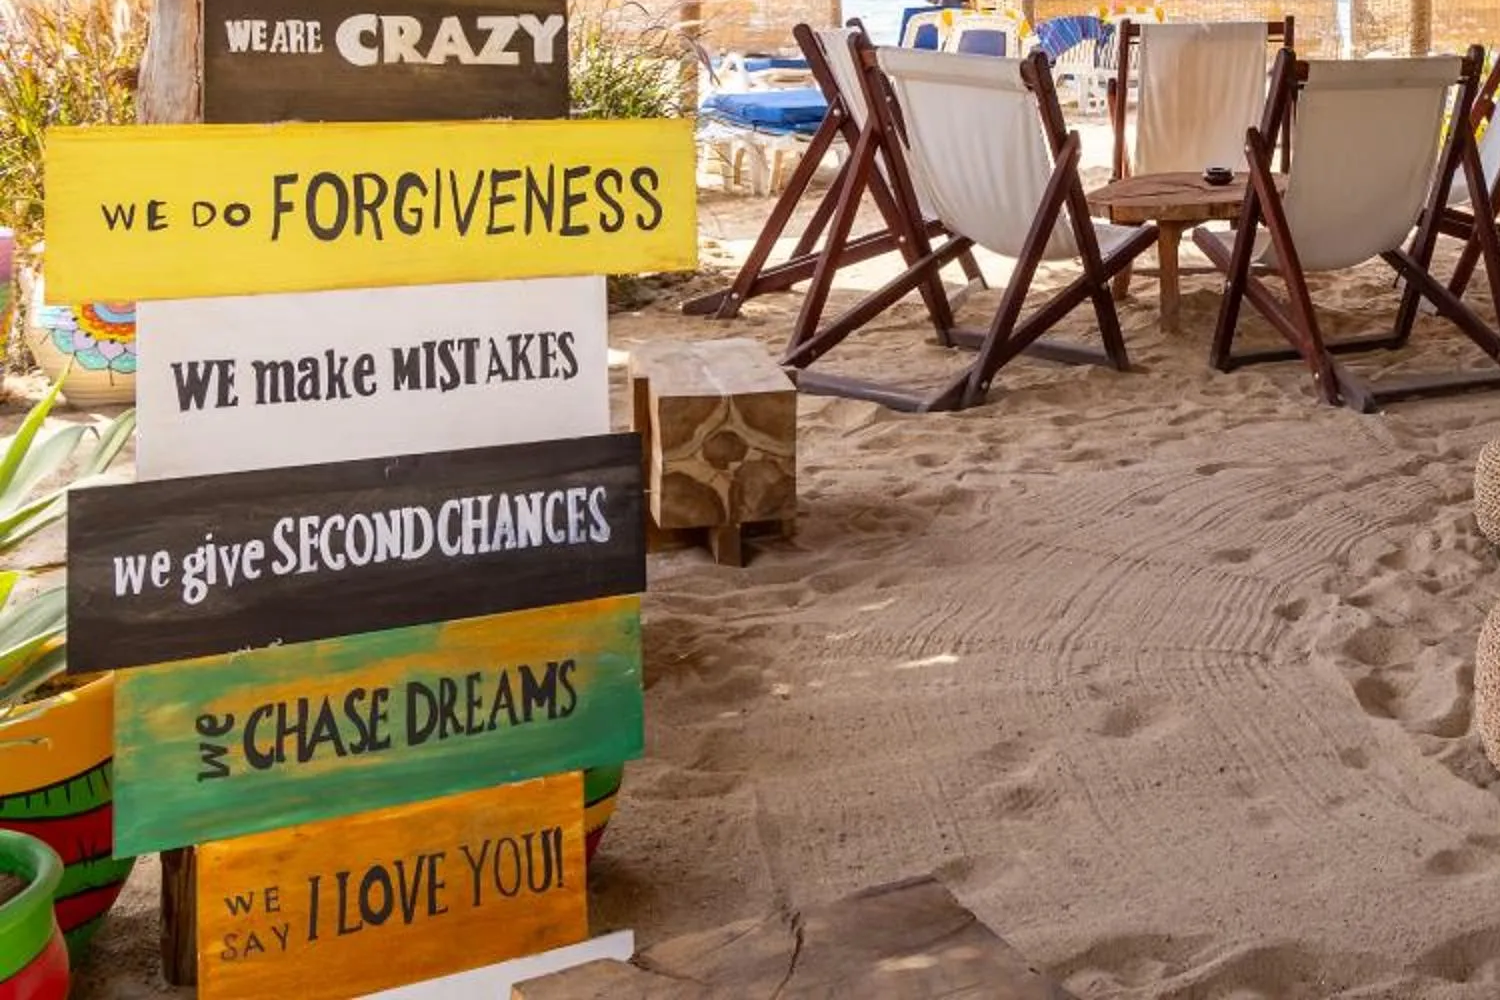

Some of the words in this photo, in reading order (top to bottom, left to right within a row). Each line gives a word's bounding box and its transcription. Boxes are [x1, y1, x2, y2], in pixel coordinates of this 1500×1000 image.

[225, 19, 267, 52] WE
[269, 18, 323, 54] ARE
[336, 13, 564, 67] CRAZY
[101, 200, 169, 232] WE
[271, 164, 663, 241] FORGIVENESS
[170, 359, 238, 412] WE
[252, 348, 377, 405] make
[392, 330, 579, 392] MISTAKES
[114, 549, 170, 596] we
[183, 532, 265, 604] give
[272, 506, 434, 577] SECOND
[436, 486, 611, 553] CHANCES
[195, 713, 234, 782] we
[243, 686, 390, 771] CHASE
[406, 659, 578, 745] DREAMS
[225, 886, 281, 915] WE
[308, 874, 320, 941] I
[335, 851, 448, 936] LOVE
[460, 827, 563, 906] YOU!
[220, 923, 289, 961] SAY
